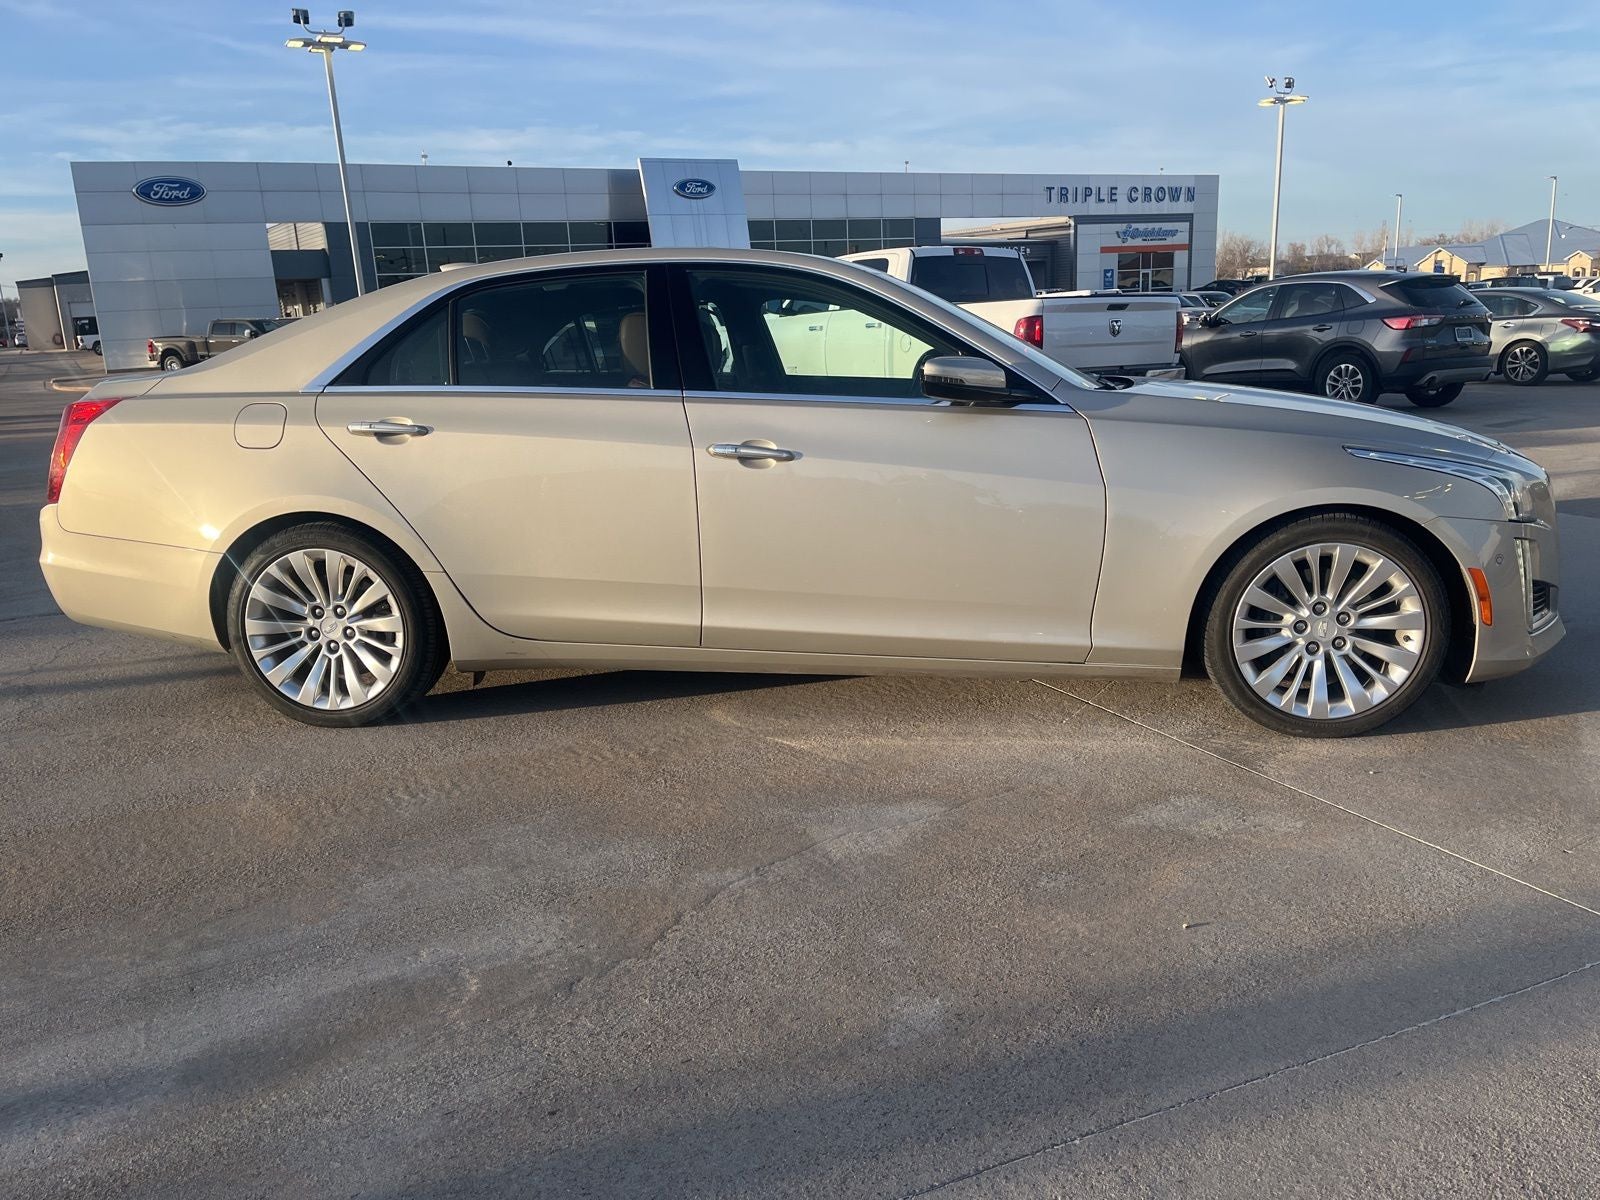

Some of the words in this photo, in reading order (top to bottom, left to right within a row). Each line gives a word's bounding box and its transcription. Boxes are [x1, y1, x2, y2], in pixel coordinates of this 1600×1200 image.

[150, 182, 191, 199] Ford
[685, 182, 708, 193] Ford
[1045, 186, 1118, 203] TRIPLE
[1127, 186, 1196, 203] CROWN
